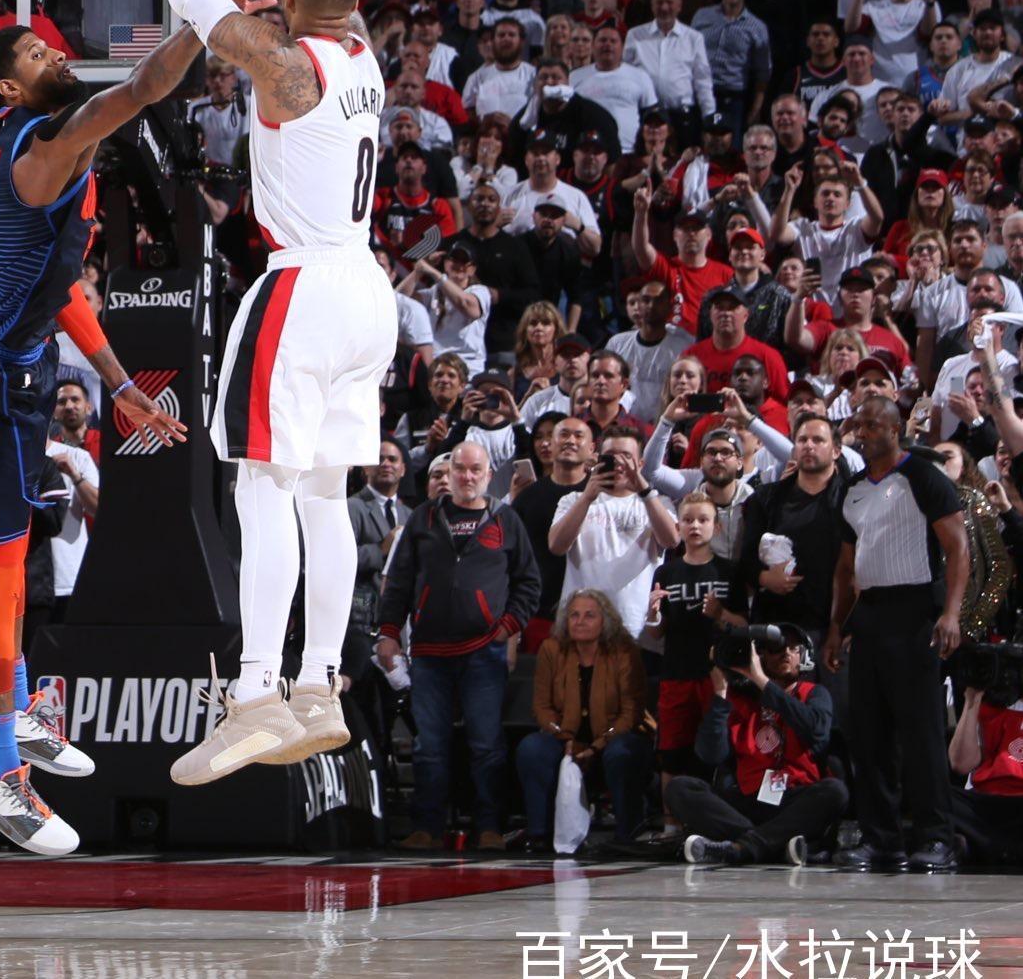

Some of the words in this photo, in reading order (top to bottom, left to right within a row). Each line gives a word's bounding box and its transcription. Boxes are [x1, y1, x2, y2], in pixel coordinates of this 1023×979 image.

[352, 137, 374, 223] 0
[108, 289, 193, 310] SPALDING
[666, 581, 729, 600] ELITE
[70, 677, 240, 744] PLAYOFF
